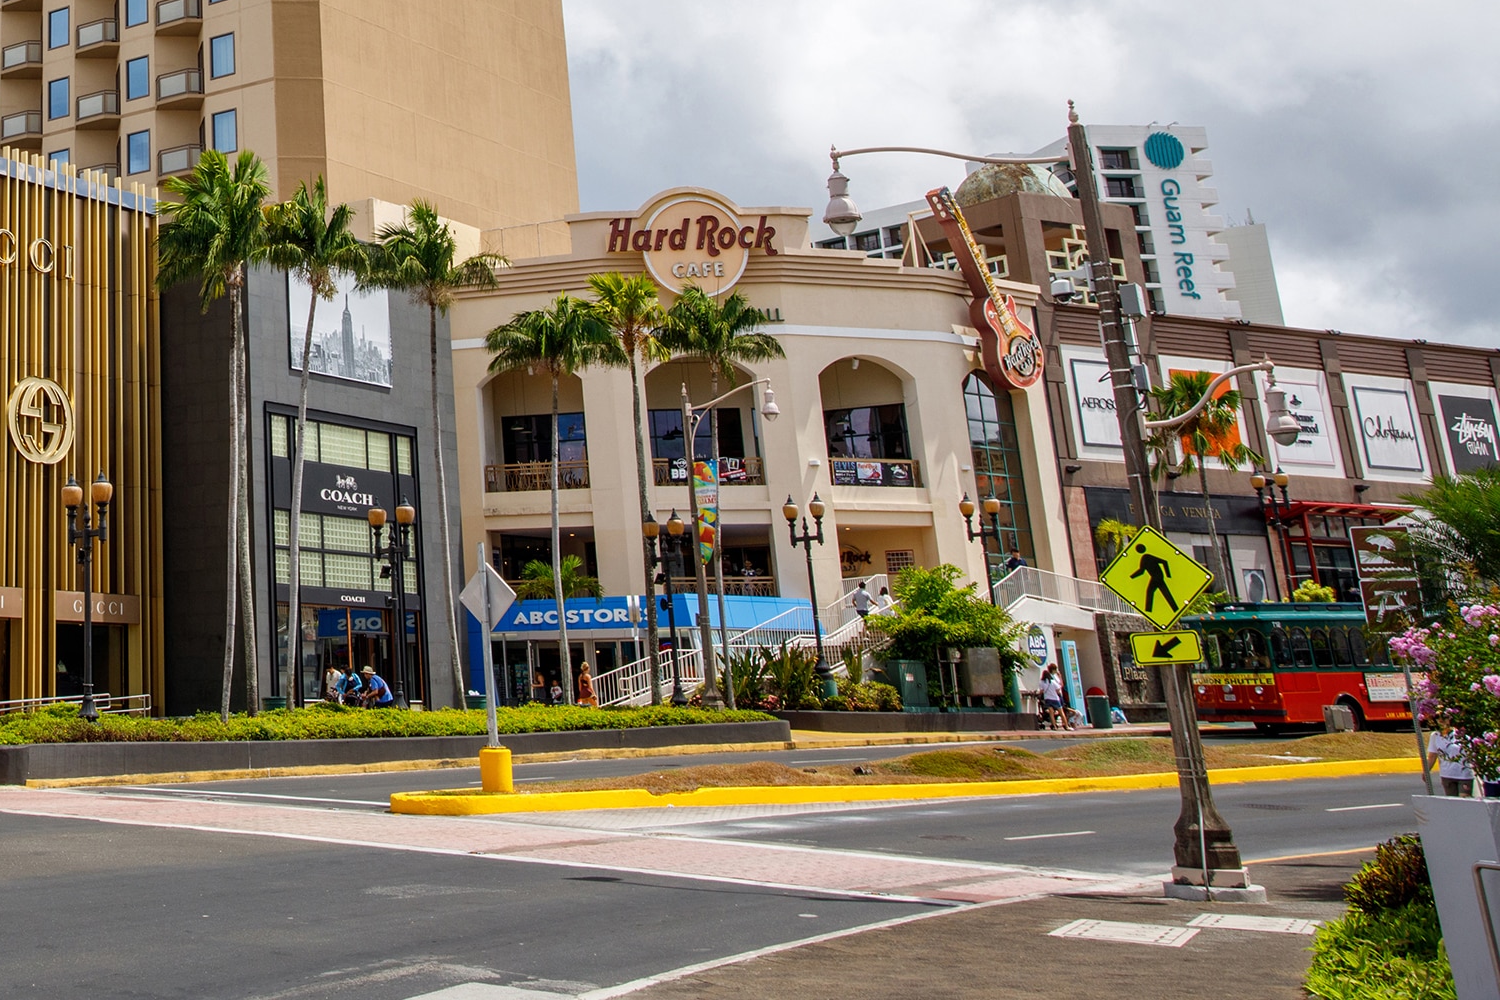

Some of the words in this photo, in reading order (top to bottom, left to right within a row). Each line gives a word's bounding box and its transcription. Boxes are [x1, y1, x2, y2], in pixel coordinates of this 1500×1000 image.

[1161, 178, 1186, 245] Guam
[608, 218, 690, 252] Hard
[696, 215, 778, 257] Rock
[672, 262, 725, 278] CAFE
[1173, 251, 1201, 300] Reef
[1082, 397, 1116, 410] AEROS
[671, 469, 688, 479] BB
[320, 488, 374, 506] COACH
[1181, 507, 1222, 519] VENA
[340, 595, 366, 603] COACH
[73, 599, 124, 615] GCCI
[513, 610, 558, 625] ABC
[566, 608, 657, 623] STOR
[1030, 635, 1046, 648] ABC
[1124, 667, 1148, 681] Plaza
[1224, 677, 1273, 685] SHUTTLE
